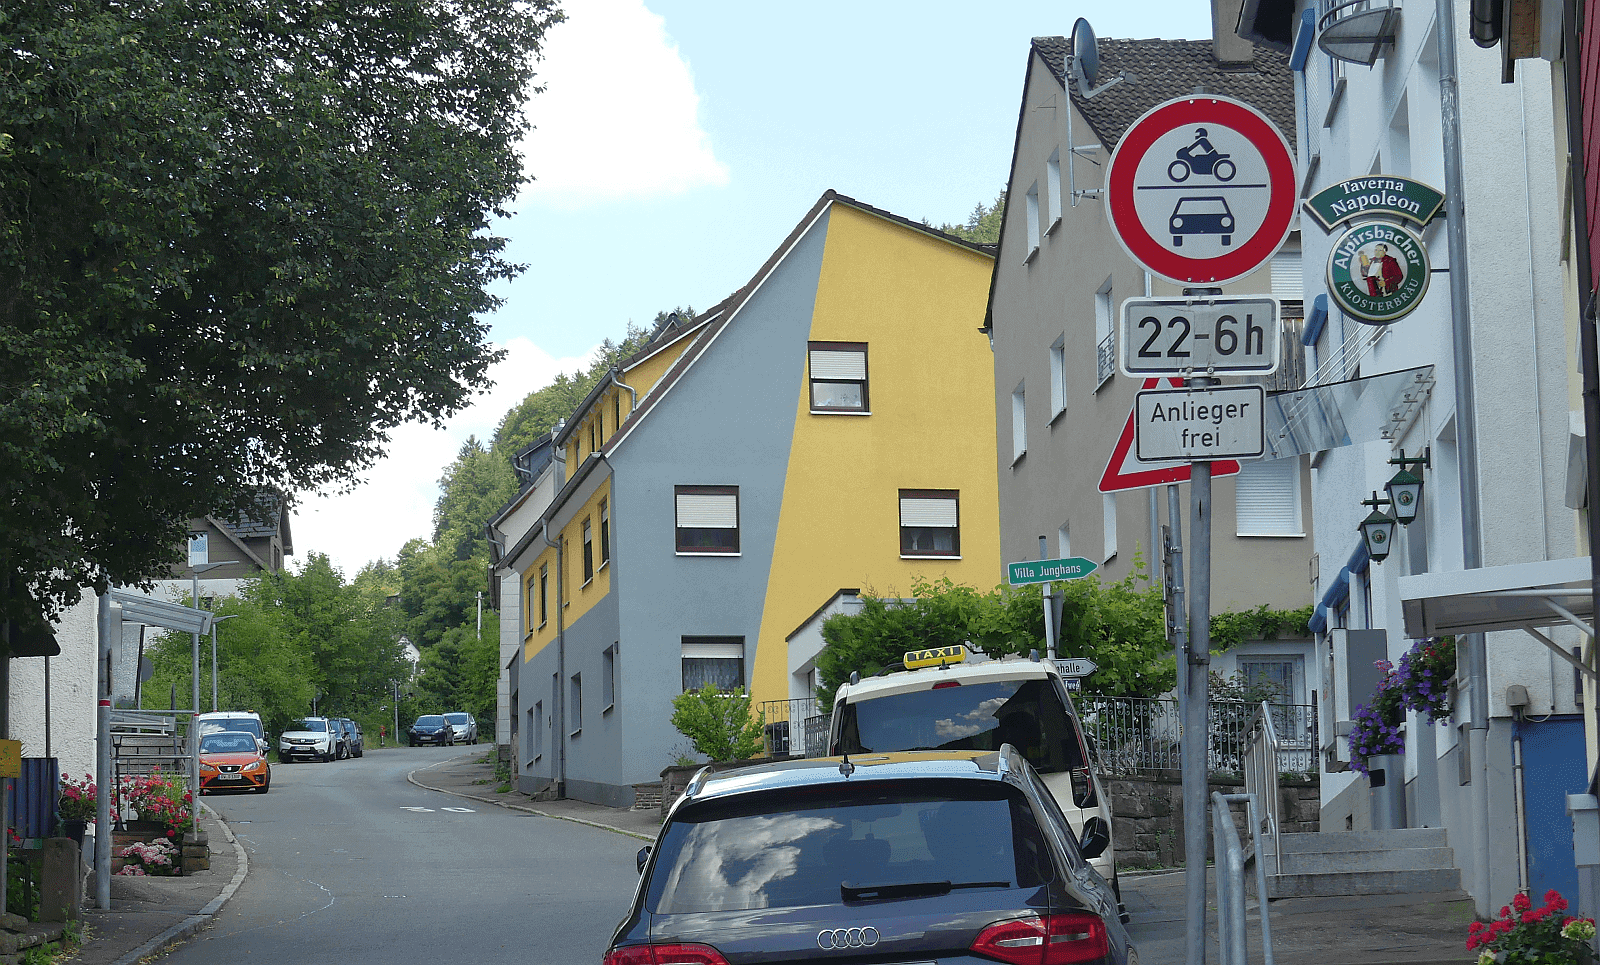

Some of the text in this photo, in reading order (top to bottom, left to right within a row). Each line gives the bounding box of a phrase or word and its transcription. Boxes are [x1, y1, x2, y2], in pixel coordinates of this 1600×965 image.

[1340, 179, 1404, 195] Taverna
[1330, 190, 1421, 217] Napoleon
[1334, 225, 1421, 270] Alpirsbacher
[1340, 278, 1419, 311] KLOSTERBRÄU
[1150, 401, 1250, 425] Anlieger
[1181, 427, 1220, 448] frei
[1014, 564, 1081, 578] Villa Junghans
[913, 647, 954, 660] TAXI
